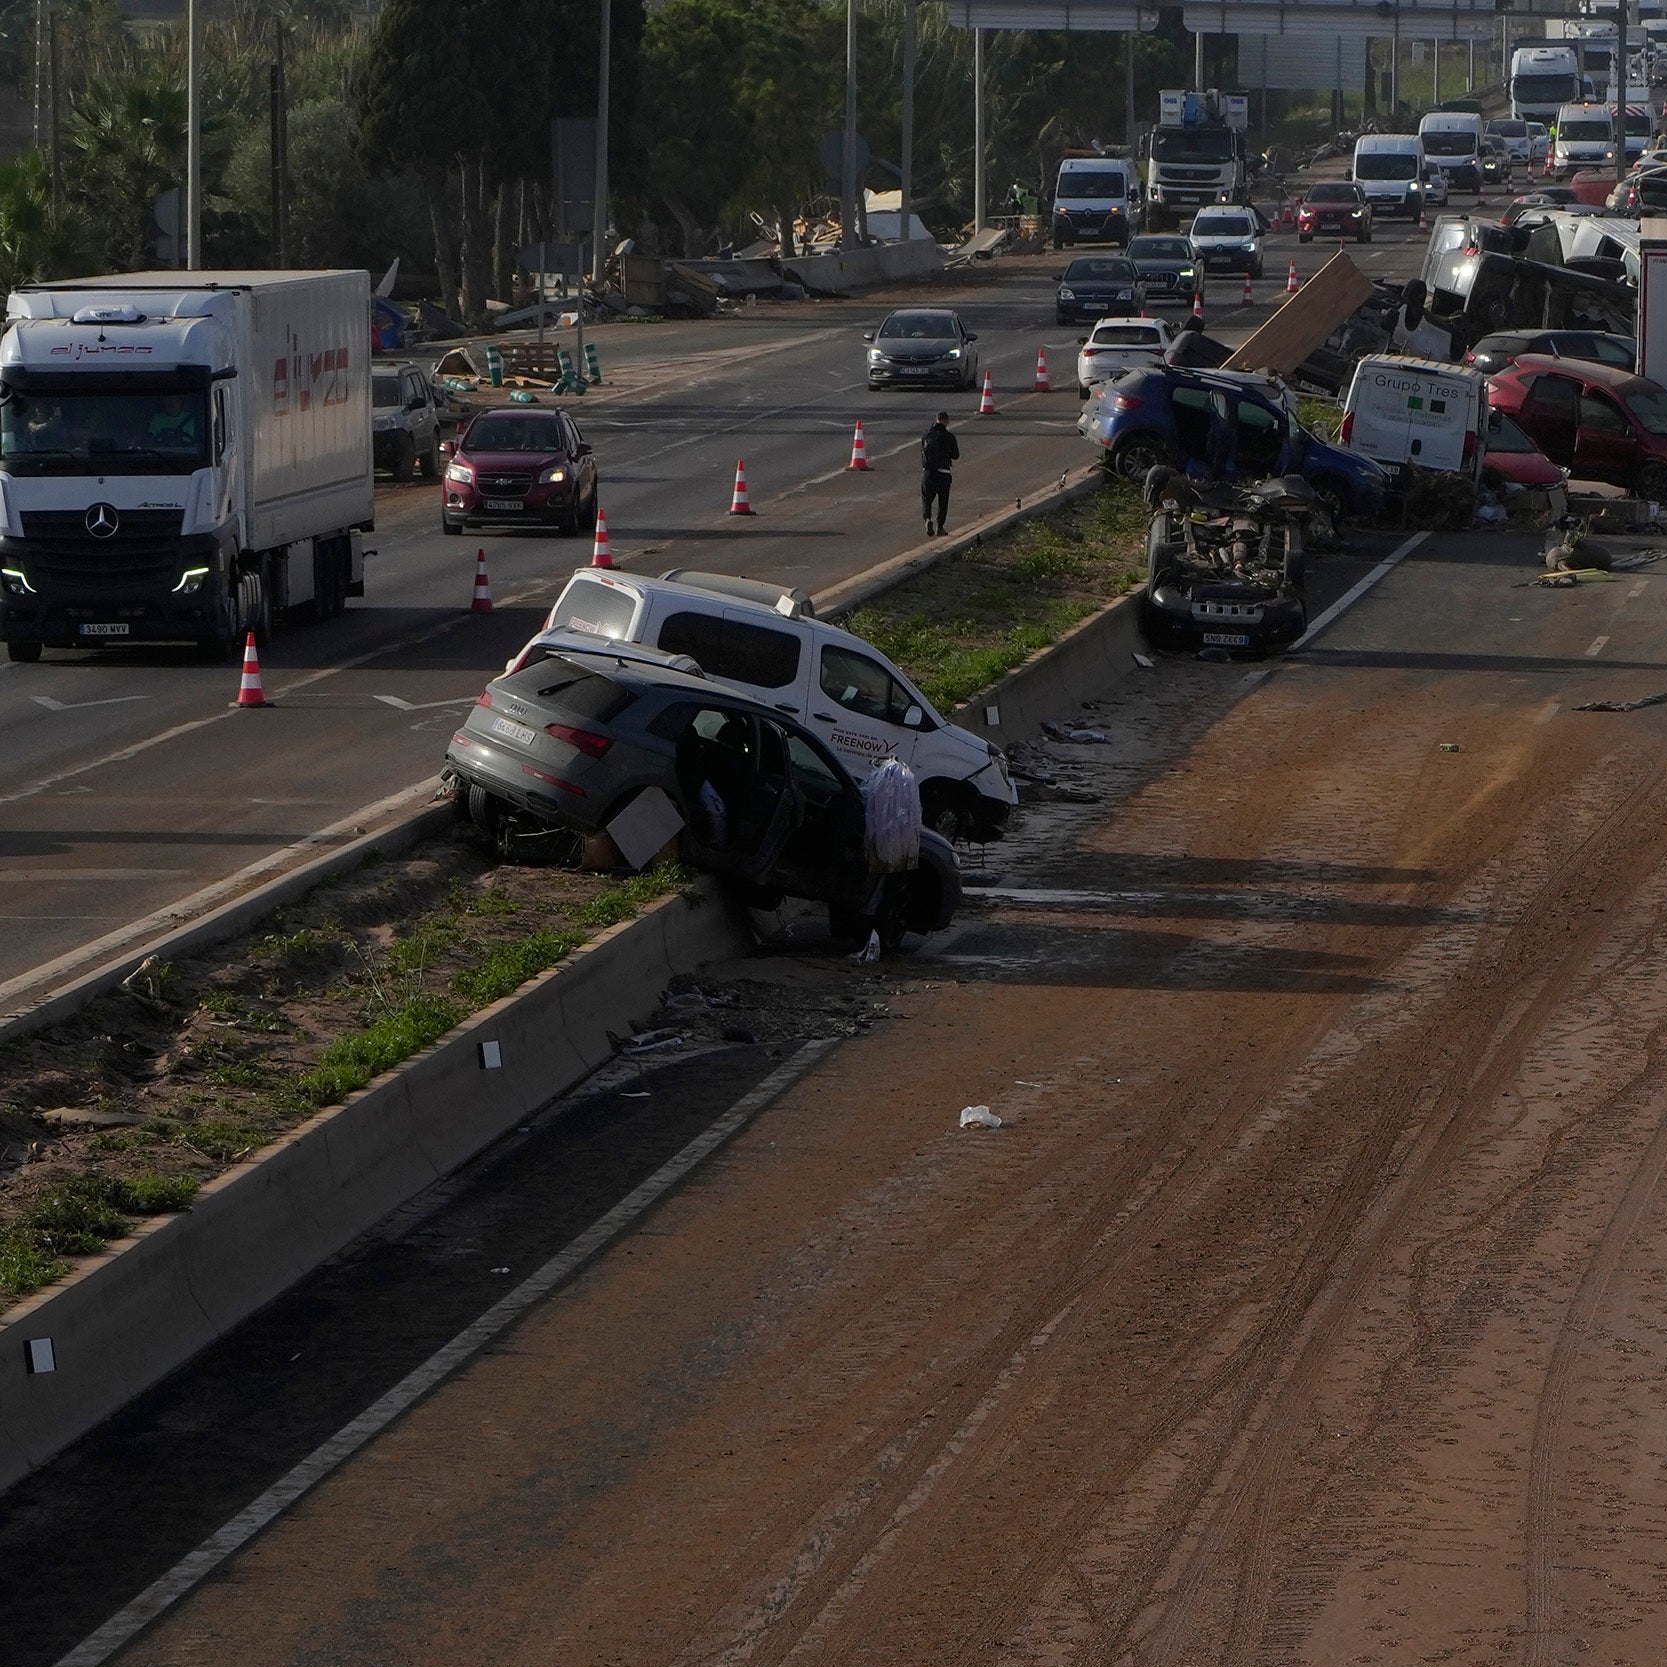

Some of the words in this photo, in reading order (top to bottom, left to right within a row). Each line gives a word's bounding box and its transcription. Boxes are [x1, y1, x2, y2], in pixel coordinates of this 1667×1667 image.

[1375, 374, 1421, 393] Grupo
[1427, 382, 1459, 399] Tres
[830, 733, 882, 752] FREENOW
